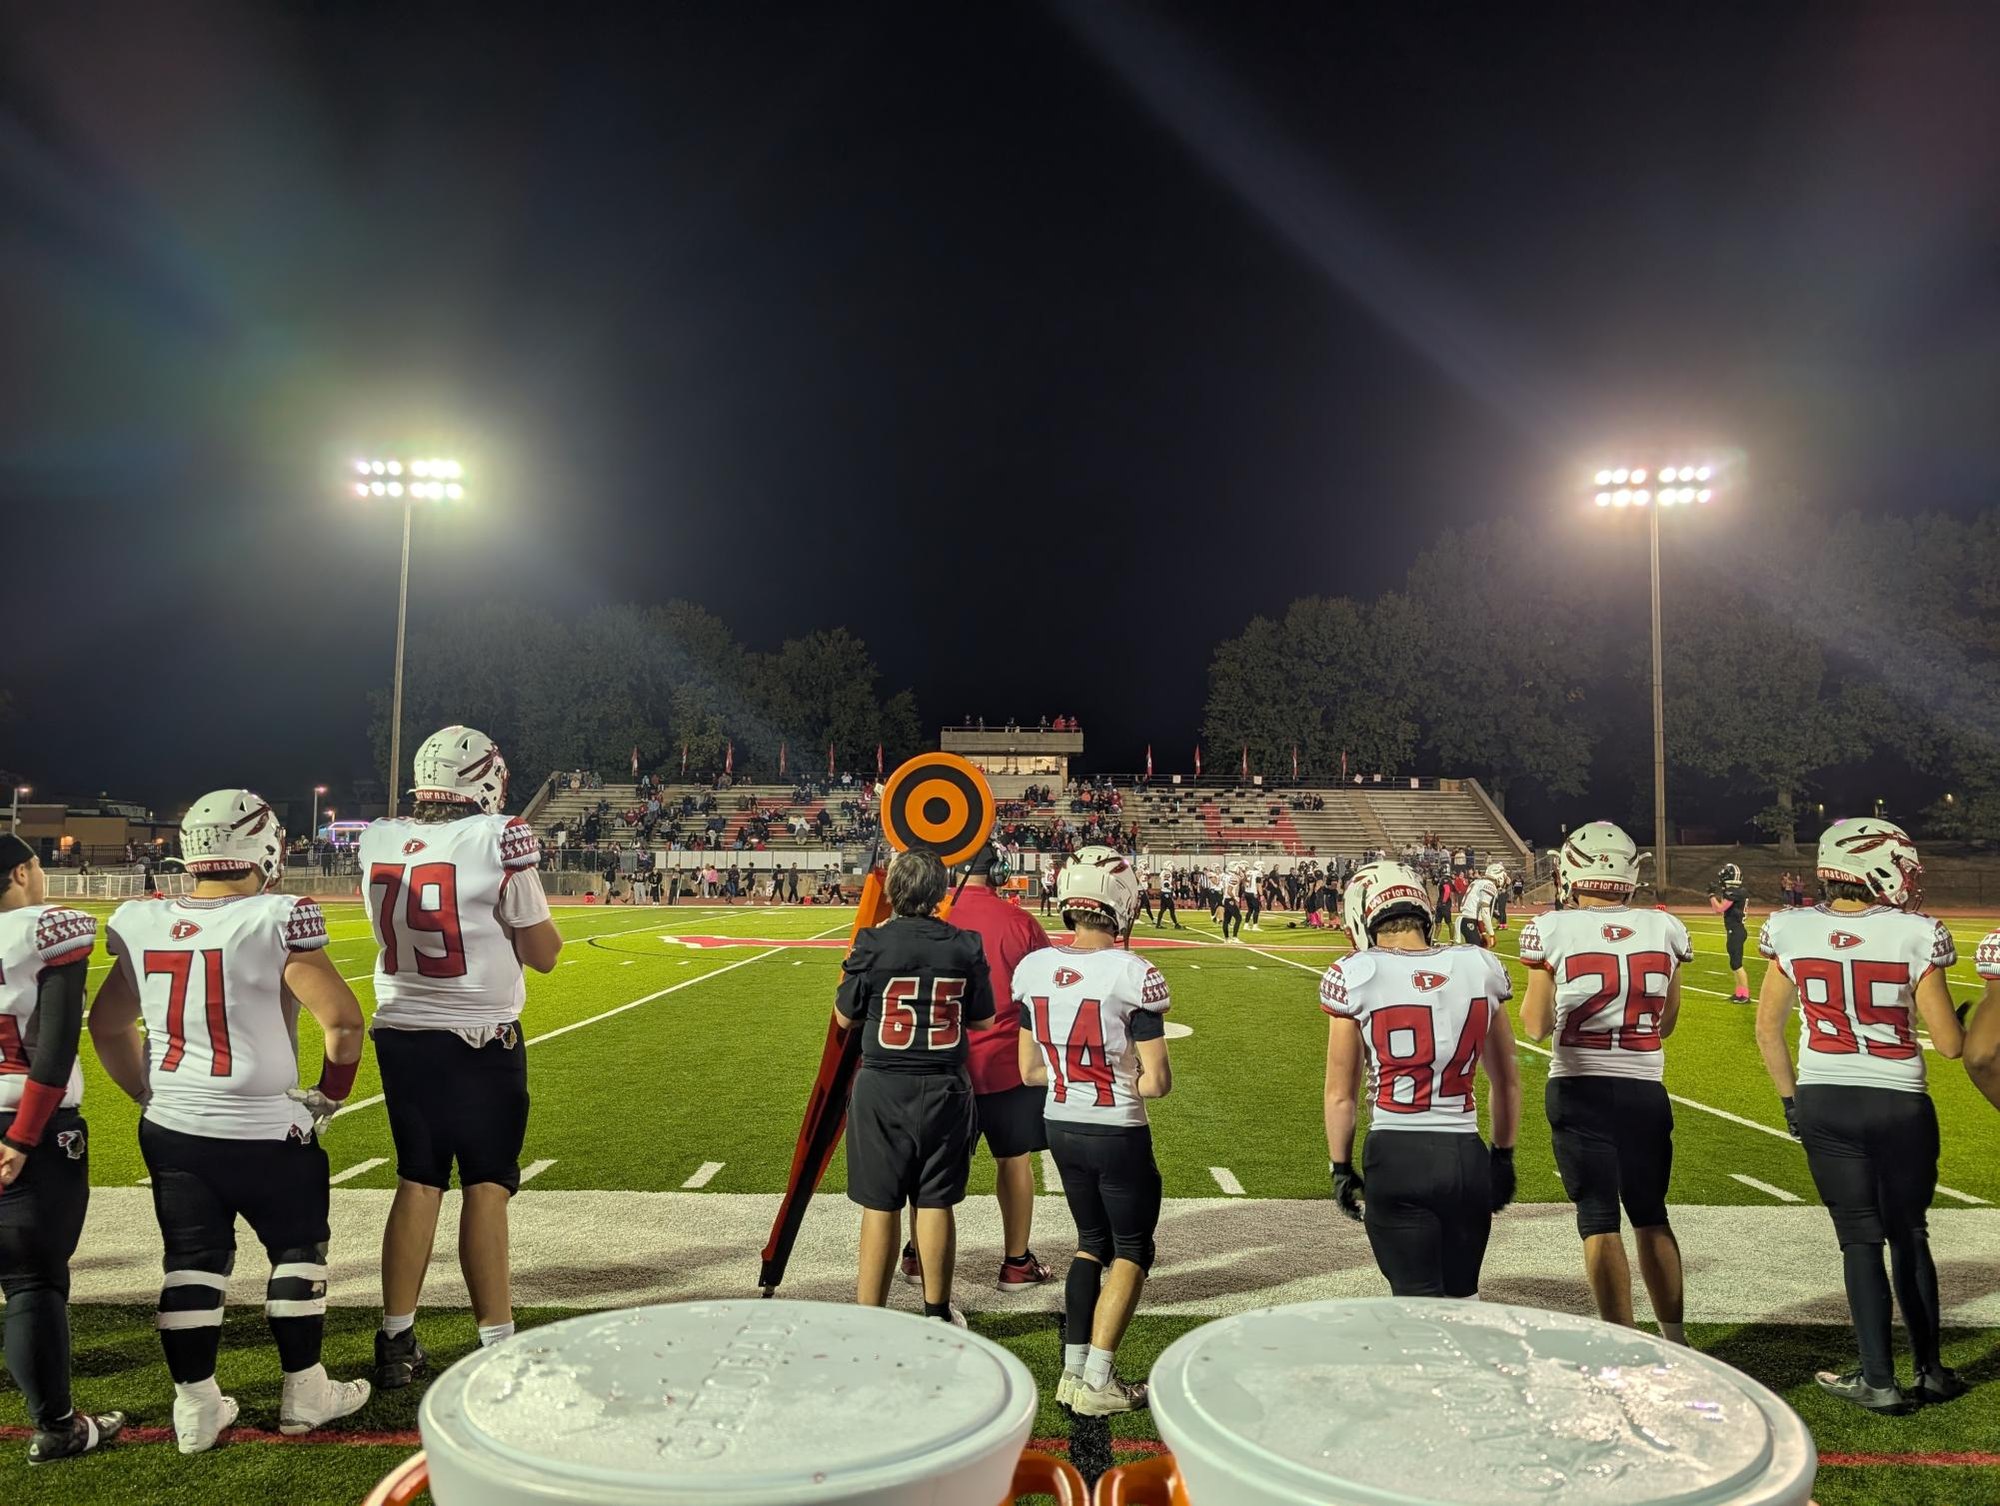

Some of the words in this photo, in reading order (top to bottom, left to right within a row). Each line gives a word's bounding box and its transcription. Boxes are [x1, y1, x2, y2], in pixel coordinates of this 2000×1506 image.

[434, 791, 467, 803] nation
[1599, 854, 1609, 863] 26
[213, 860, 251, 871] nation
[1824, 868, 1857, 883] nation
[1577, 880, 1613, 891] warrior
[370, 862, 467, 978] 79
[179, 925, 191, 938] F
[1611, 927, 1622, 939] F
[1839, 935, 1850, 947] F
[1062, 972, 1073, 984] F
[1422, 975, 1434, 988] F
[1559, 950, 1672, 1052] 26
[143, 948, 232, 1077] 71
[878, 976, 967, 1050] 65
[1791, 957, 1918, 1060] 85
[1030, 996, 1117, 1107] 14
[1370, 997, 1489, 1114] 84
